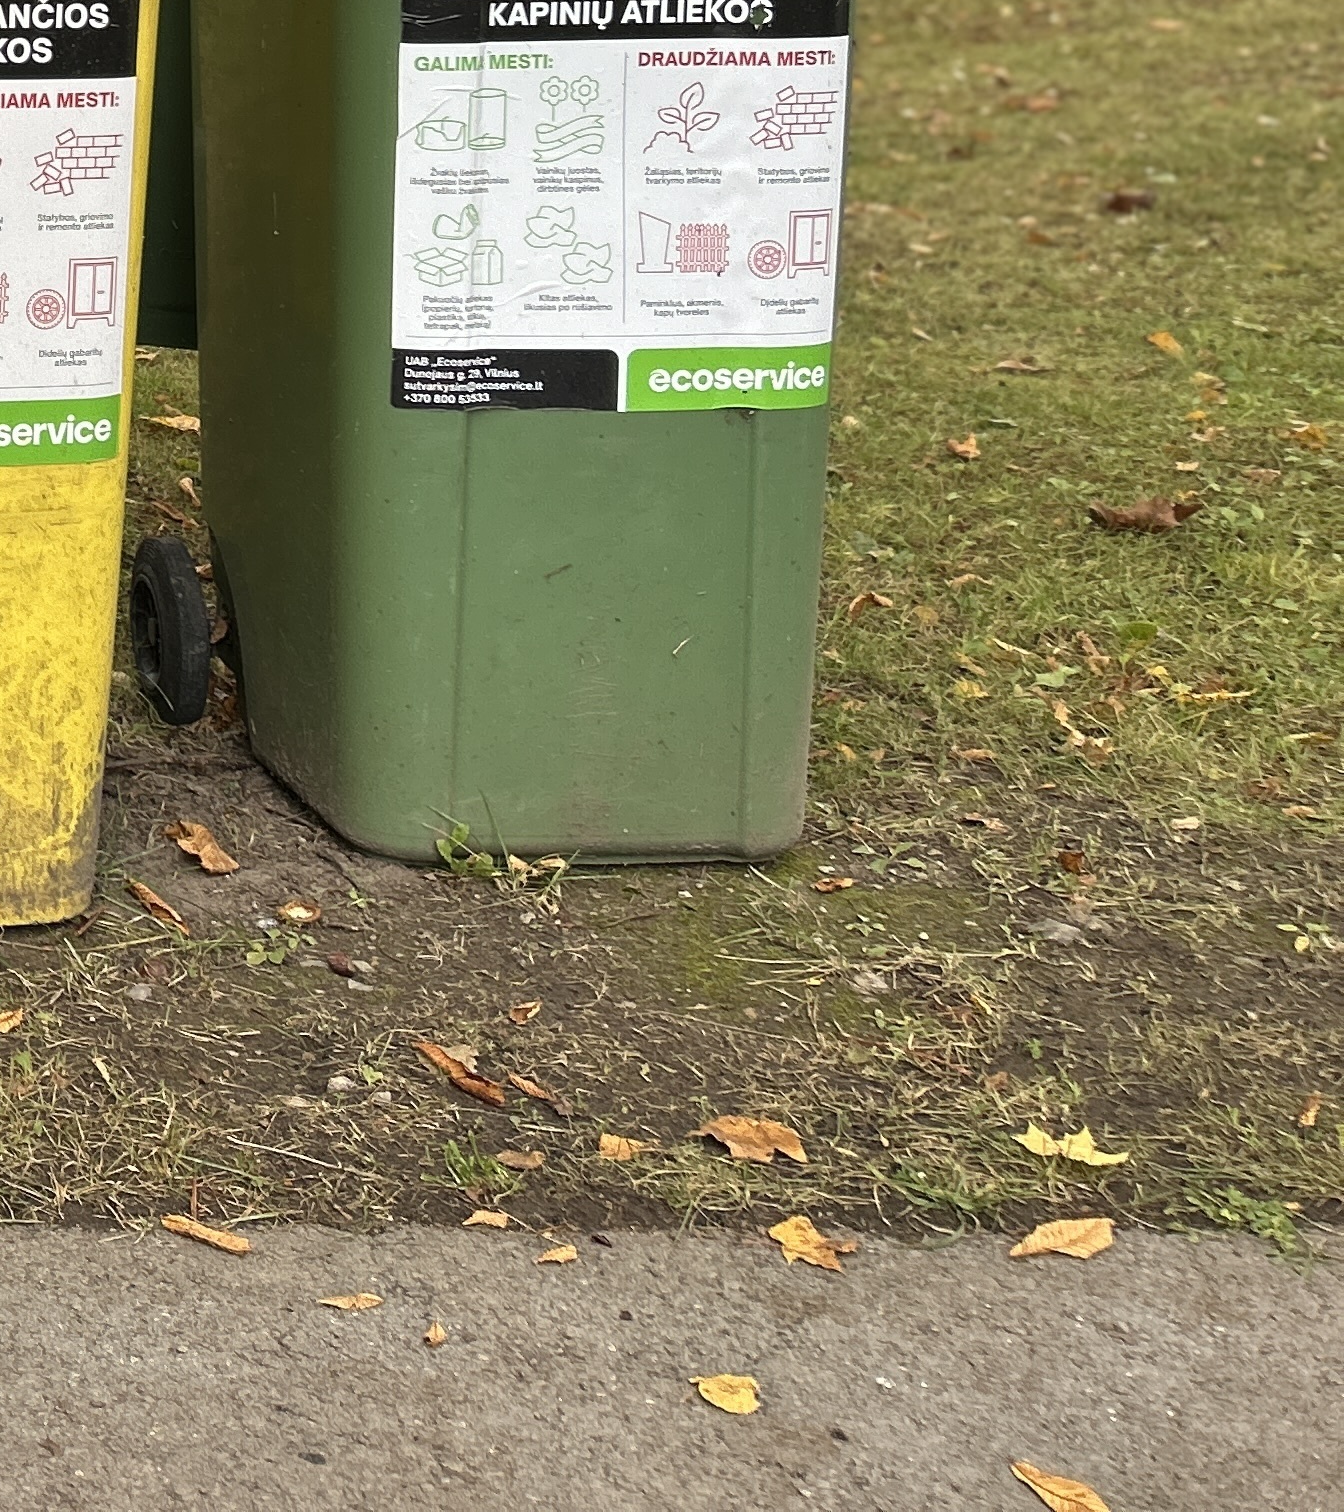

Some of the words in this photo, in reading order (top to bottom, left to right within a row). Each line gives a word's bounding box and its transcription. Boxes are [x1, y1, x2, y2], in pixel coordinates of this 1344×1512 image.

[488, 1, 611, 30] KAPINIŲ
[489, 53, 554, 70] MESTI:
[638, 48, 771, 68] DRAUDŽIAMA
[777, 50, 835, 66] MESTI:
[56, 91, 119, 108] MESTI:
[405, 356, 429, 366] UAB
[485, 368, 520, 378] Vilnius
[648, 360, 824, 393] ecoservice
[404, 394, 431, 403] +370
[434, 394, 455, 403] 800
